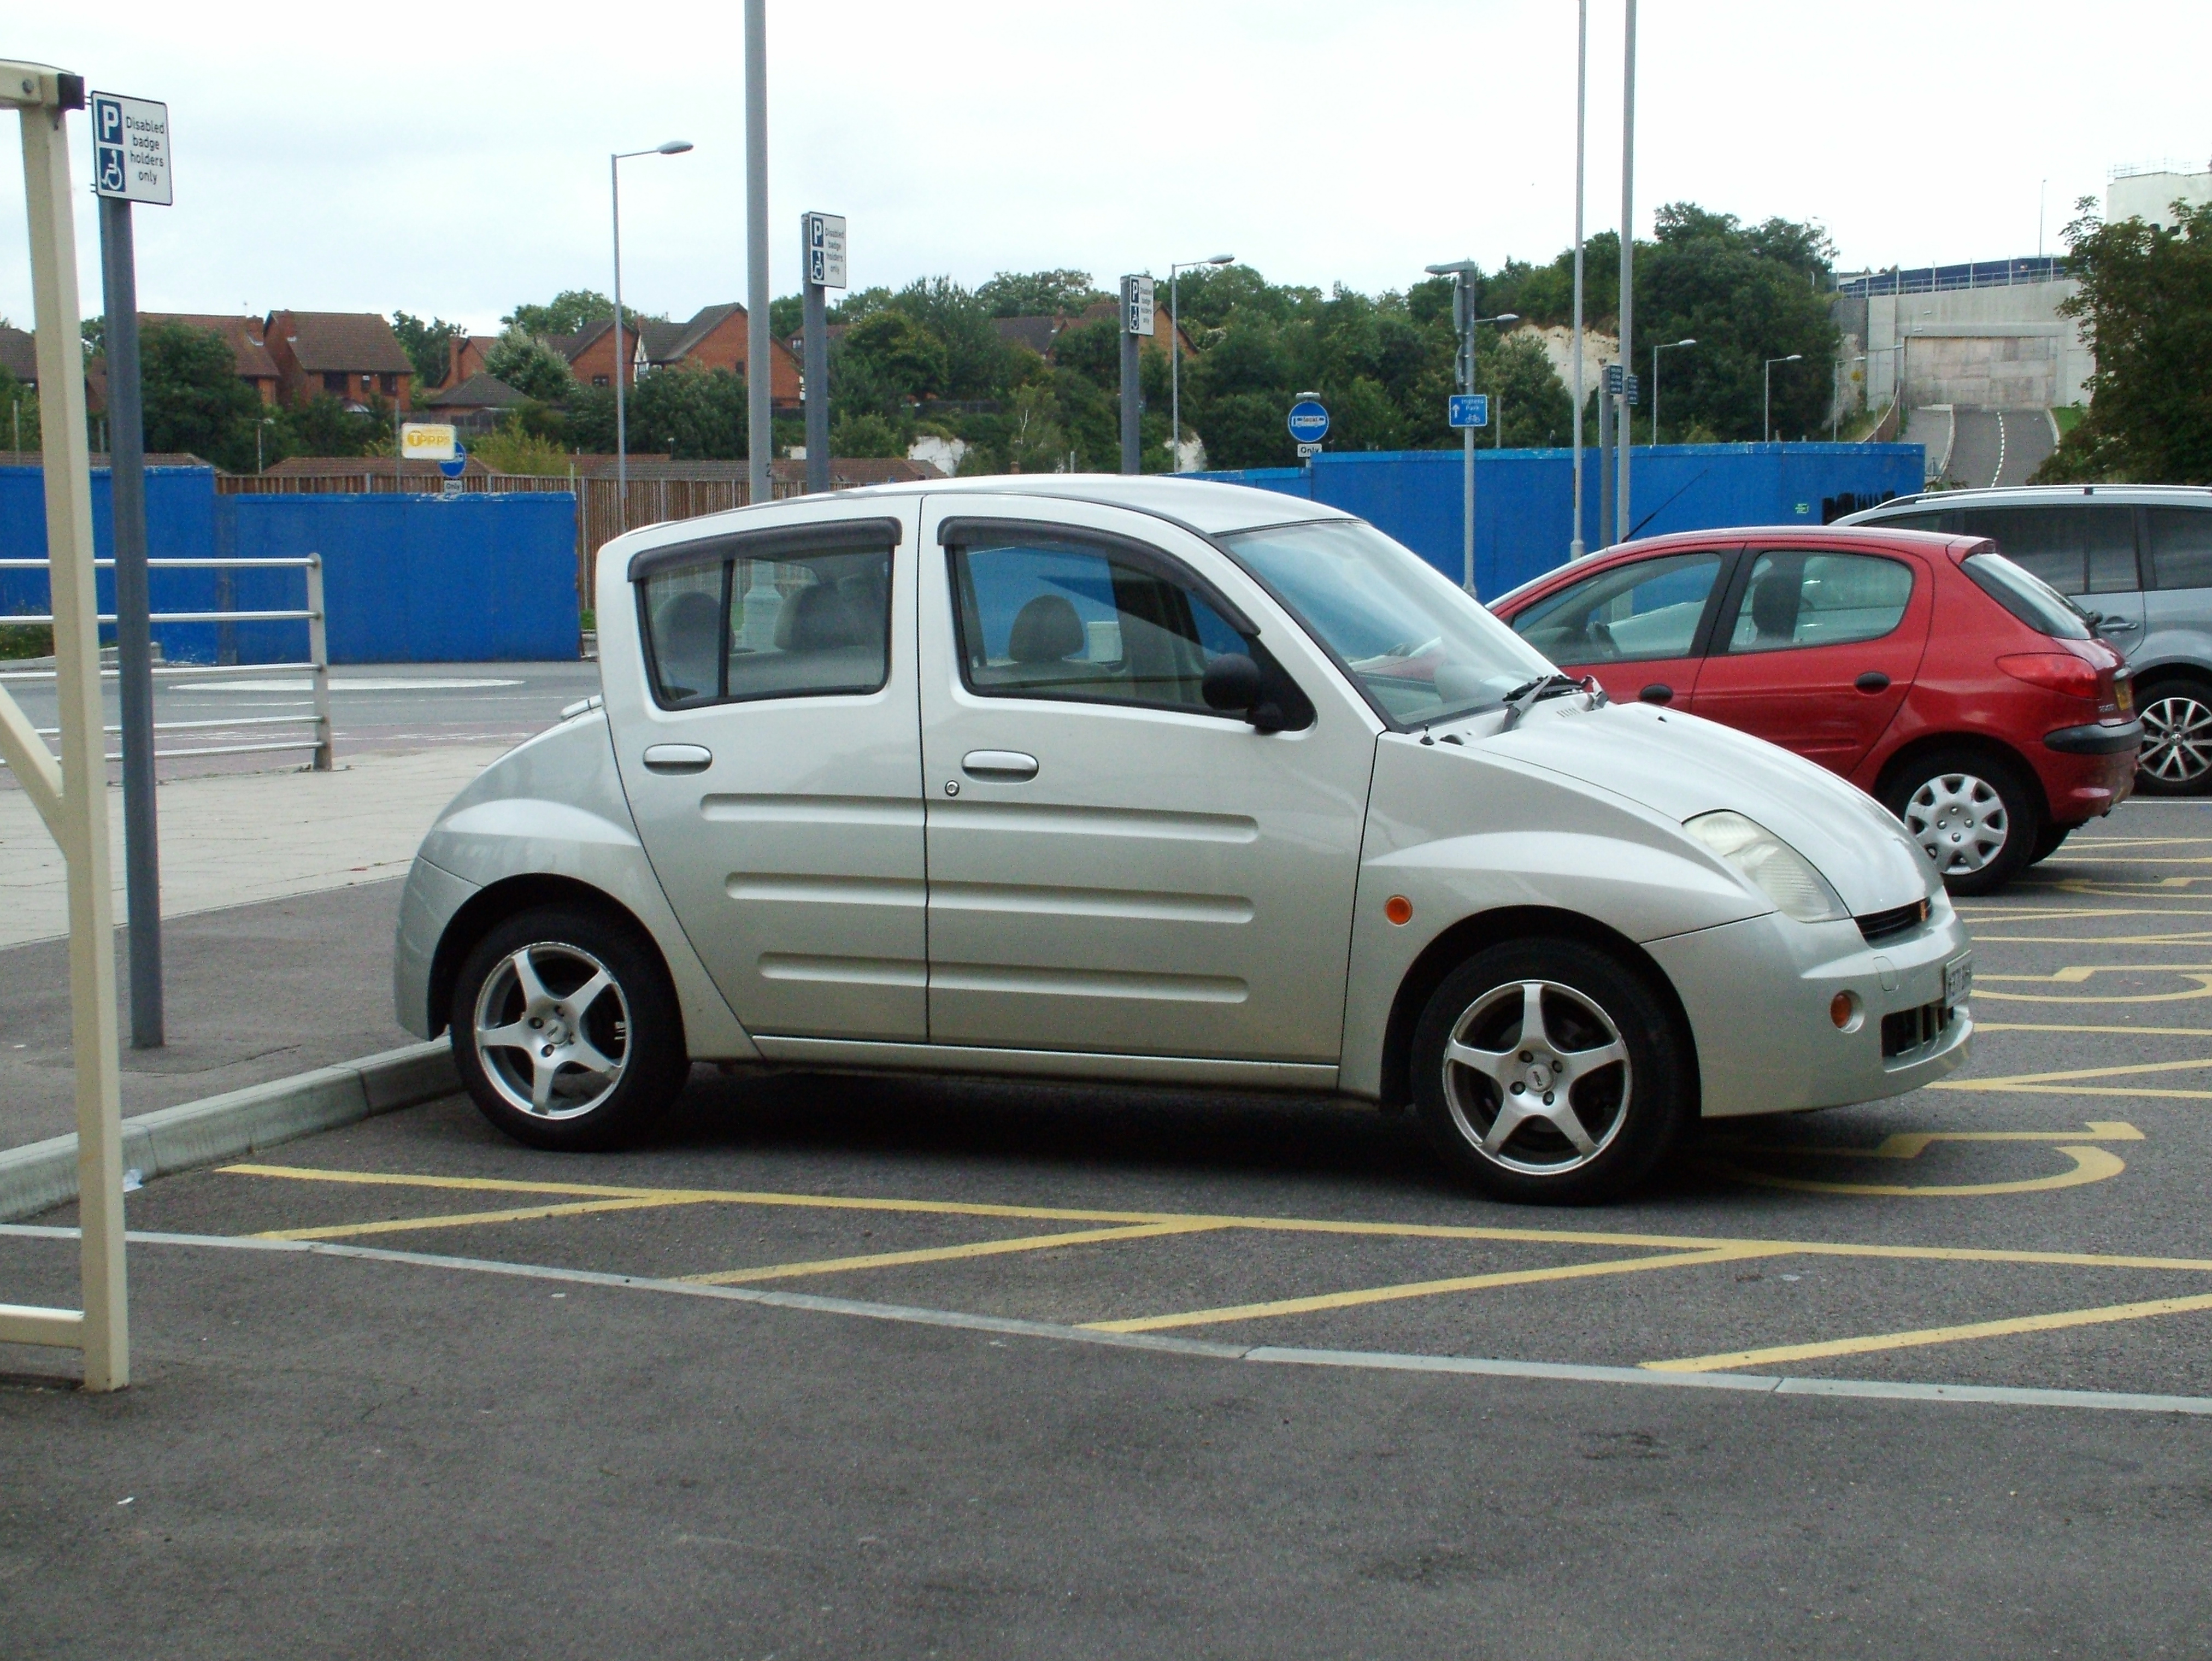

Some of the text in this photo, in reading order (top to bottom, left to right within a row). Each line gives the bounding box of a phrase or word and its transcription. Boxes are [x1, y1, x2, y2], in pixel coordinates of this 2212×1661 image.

[102, 105, 119, 139] P
[126, 115, 164, 134] Disabled
[132, 134, 160, 151] badge
[130, 150, 164, 167] holders
[138, 169, 157, 185] only
[814, 221, 822, 245] P
[1132, 281, 1138, 301] P
